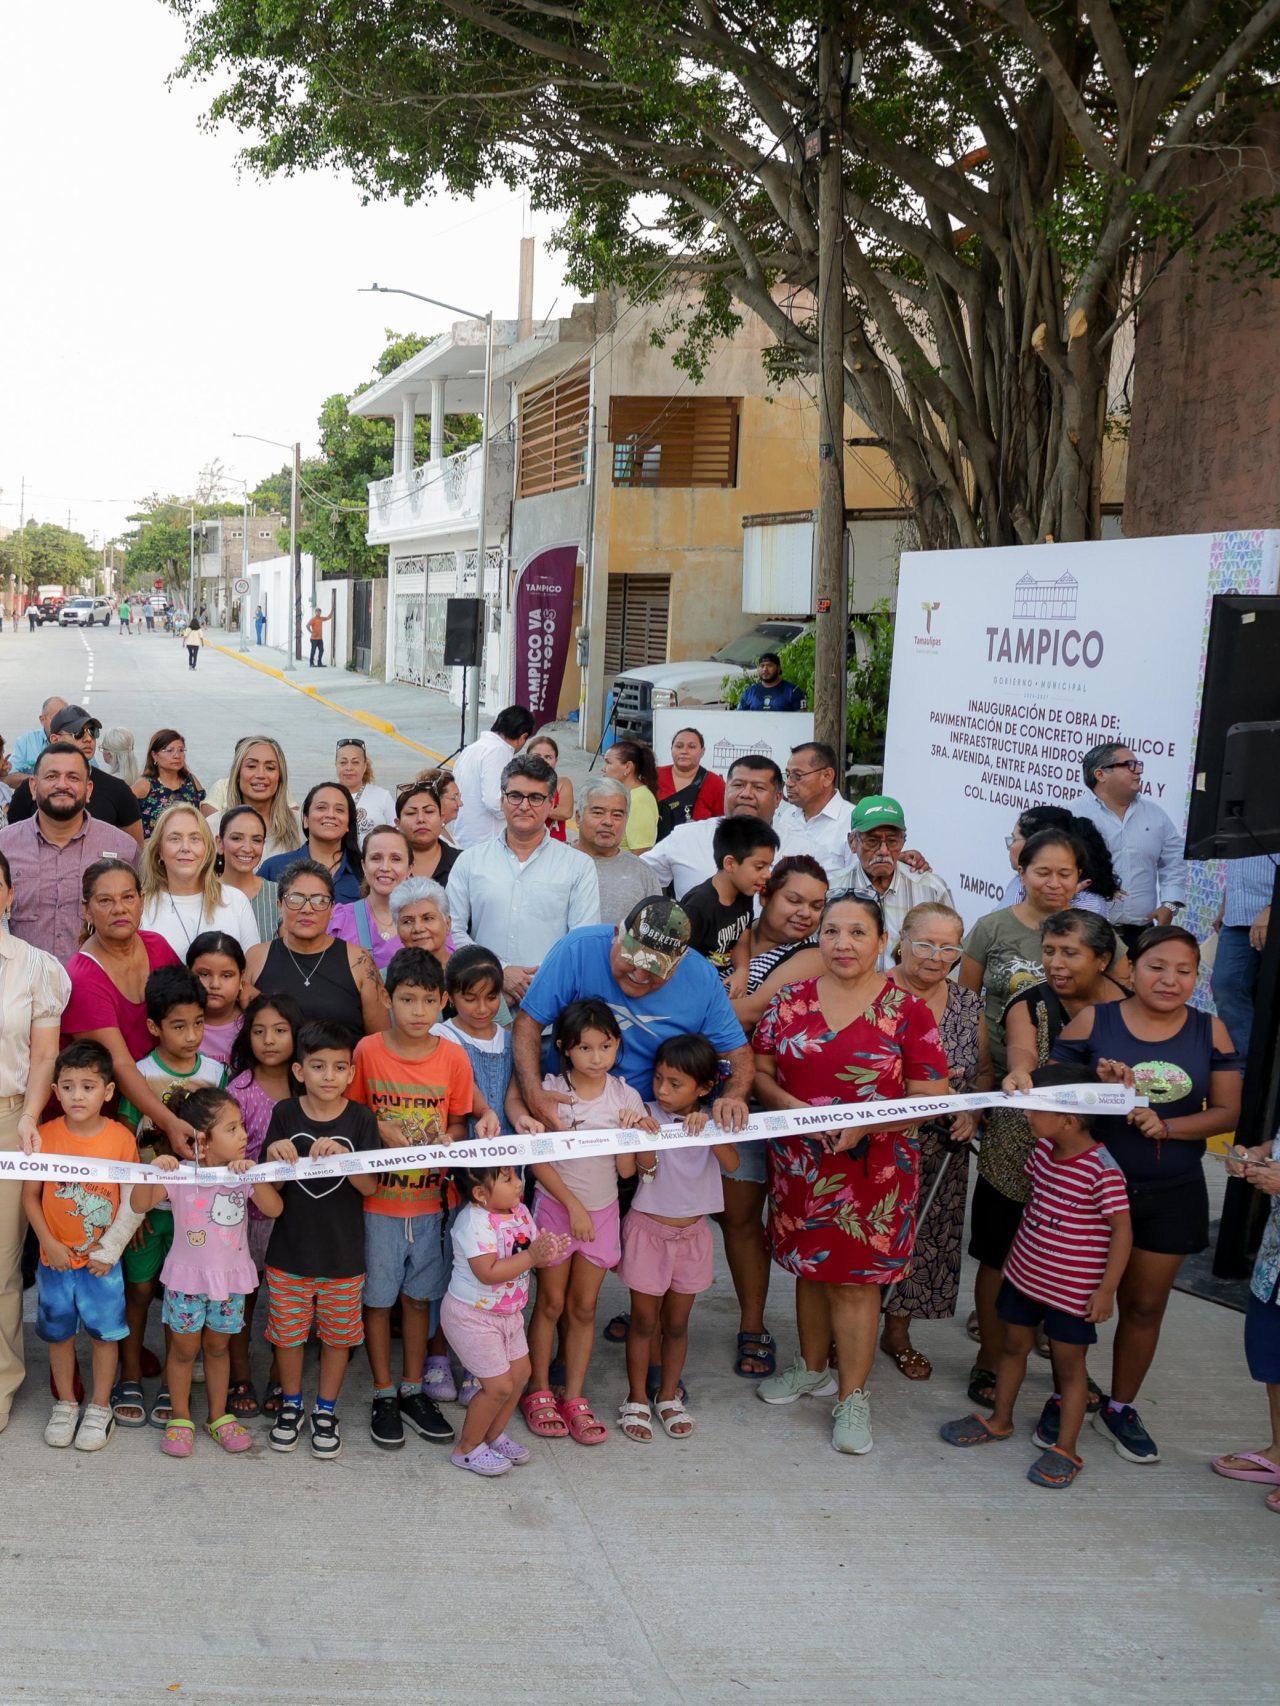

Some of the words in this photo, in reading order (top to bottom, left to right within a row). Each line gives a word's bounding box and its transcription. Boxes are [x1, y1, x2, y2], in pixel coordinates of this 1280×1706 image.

[526, 583, 562, 593] TAMPICO
[528, 608, 542, 631] VA
[914, 635, 942, 648] Tamaulipas
[986, 627, 1104, 668] TAMPICO
[528, 634, 542, 712] TAMPICO
[993, 676, 1033, 688] GOBIERNO
[1040, 681, 1087, 693] MUNICIPAL
[968, 699, 1045, 721] INAUGURACIÓN
[1049, 709, 1062, 722] DE
[1065, 711, 1097, 727] OBRA
[1101, 714, 1120, 730] DE:
[930, 711, 1002, 733] PAVIMENTACIÓN
[1005, 722, 1017, 735] DE
[1020, 724, 1082, 744] CONCRETO
[1168, 742, 1175, 757] E
[950, 731, 1038, 757] INFRAESTRUCTURA
[1041, 745, 1084, 764] HIDROS
[931, 744, 950, 759] 3RA.
[952, 748, 993, 769] AVENIDA,
[996, 757, 1025, 773] ENTRE
[1027, 762, 1063, 779] PASEO
[1066, 768, 1080, 782] DE
[1157, 783, 1165, 797] Y
[981, 771, 1021, 790] AVENIDA
[1024, 779, 1043, 795] LAS
[1046, 783, 1083, 800] TORRE
[964, 784, 987, 801] COL.
[989, 790, 1030, 810] LAGUNA
[959, 873, 1004, 901] TAMPICO
[648, 930, 681, 948] BERETTA
[372, 1093, 445, 1108] MUTANT
[793, 1112, 854, 1126] TAMPICO
[857, 1109, 875, 1120] VA
[877, 1105, 908, 1117] CON
[578, 1137, 610, 1145] Tamaulipas
[660, 1130, 690, 1140] México
[0, 1161, 16, 1171] VA
[19, 1161, 48, 1172] CON
[368, 1153, 427, 1168] TAMPICO
[430, 1150, 447, 1160] VA
[449, 1147, 478, 1159] CON
[156, 1174, 187, 1182] Tamaulipas
[303, 1169, 335, 1177] TAMPICO
